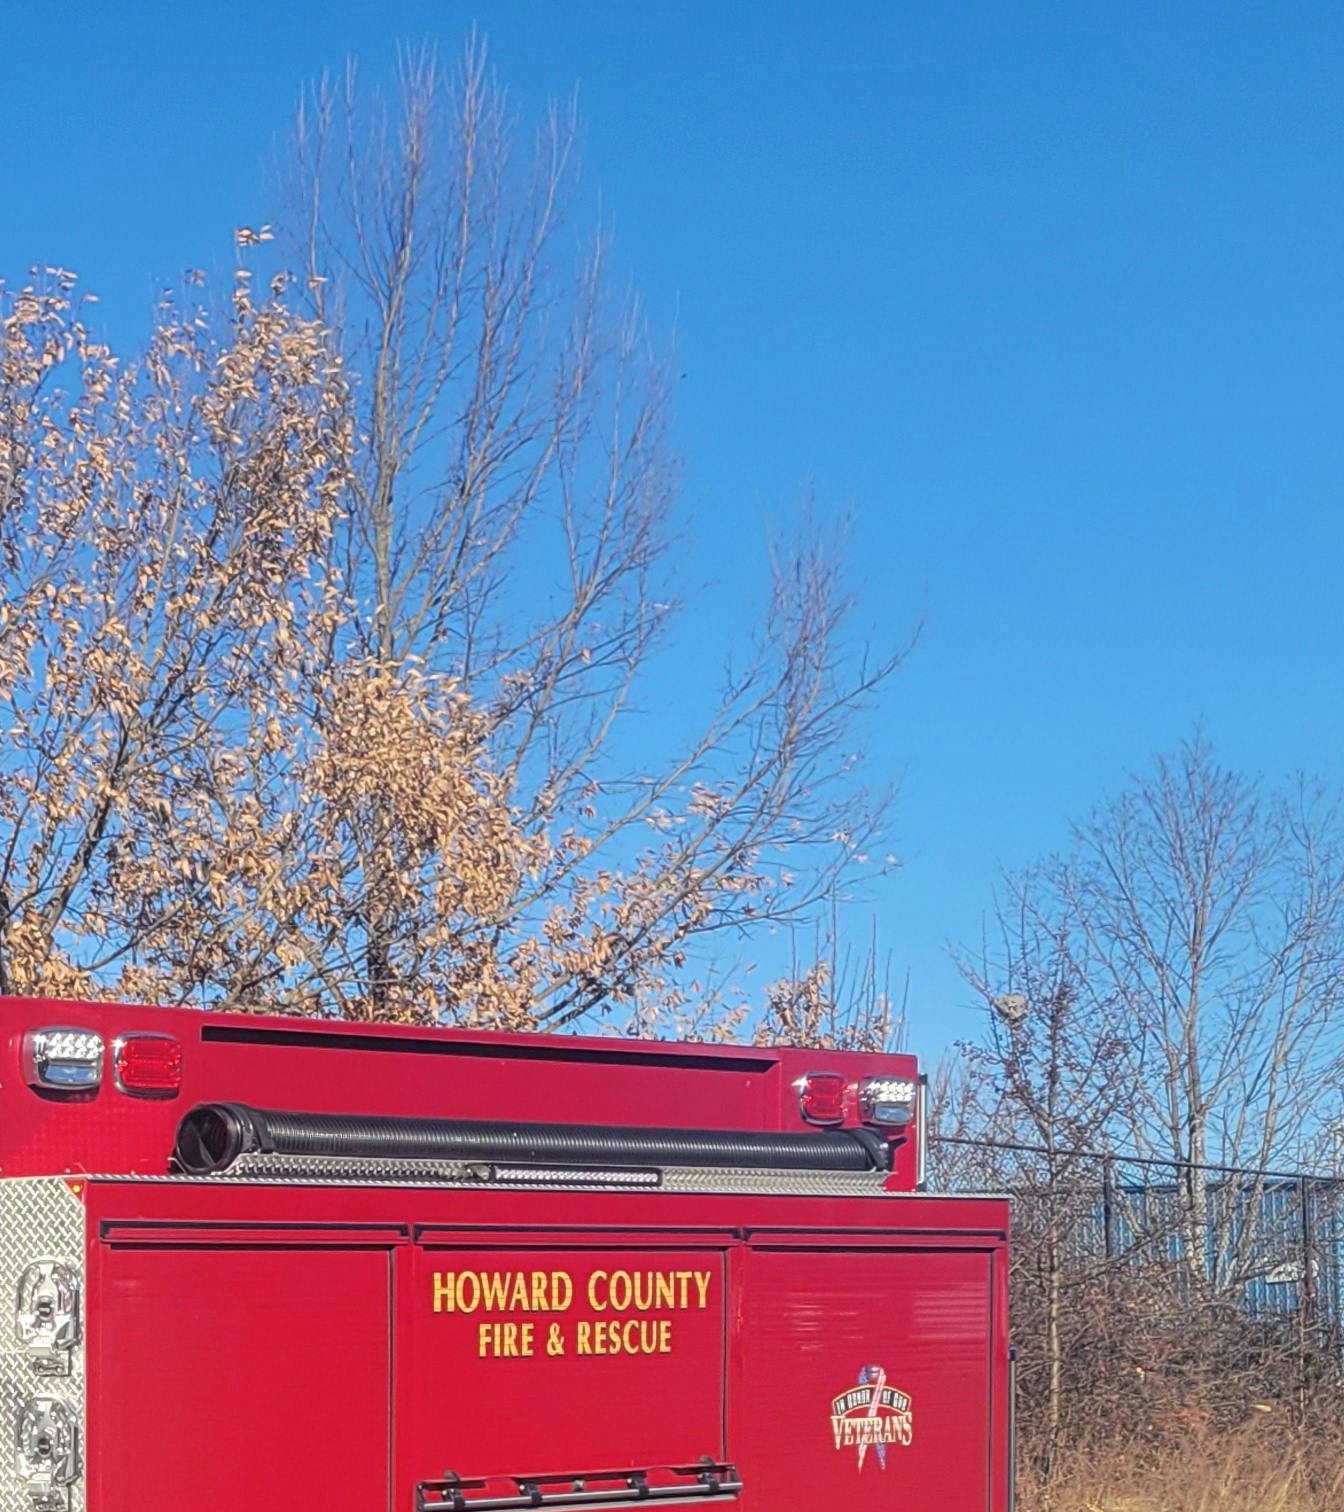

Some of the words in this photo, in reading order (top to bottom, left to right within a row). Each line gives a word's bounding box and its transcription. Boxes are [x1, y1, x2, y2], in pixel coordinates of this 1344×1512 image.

[433, 1271, 573, 1313] HOWARD
[588, 1270, 711, 1311] COUNTY
[479, 1323, 534, 1357] FIRE
[546, 1322, 565, 1356] &
[577, 1320, 672, 1355] RESCUE
[830, 1412, 912, 1450] VETERANS
